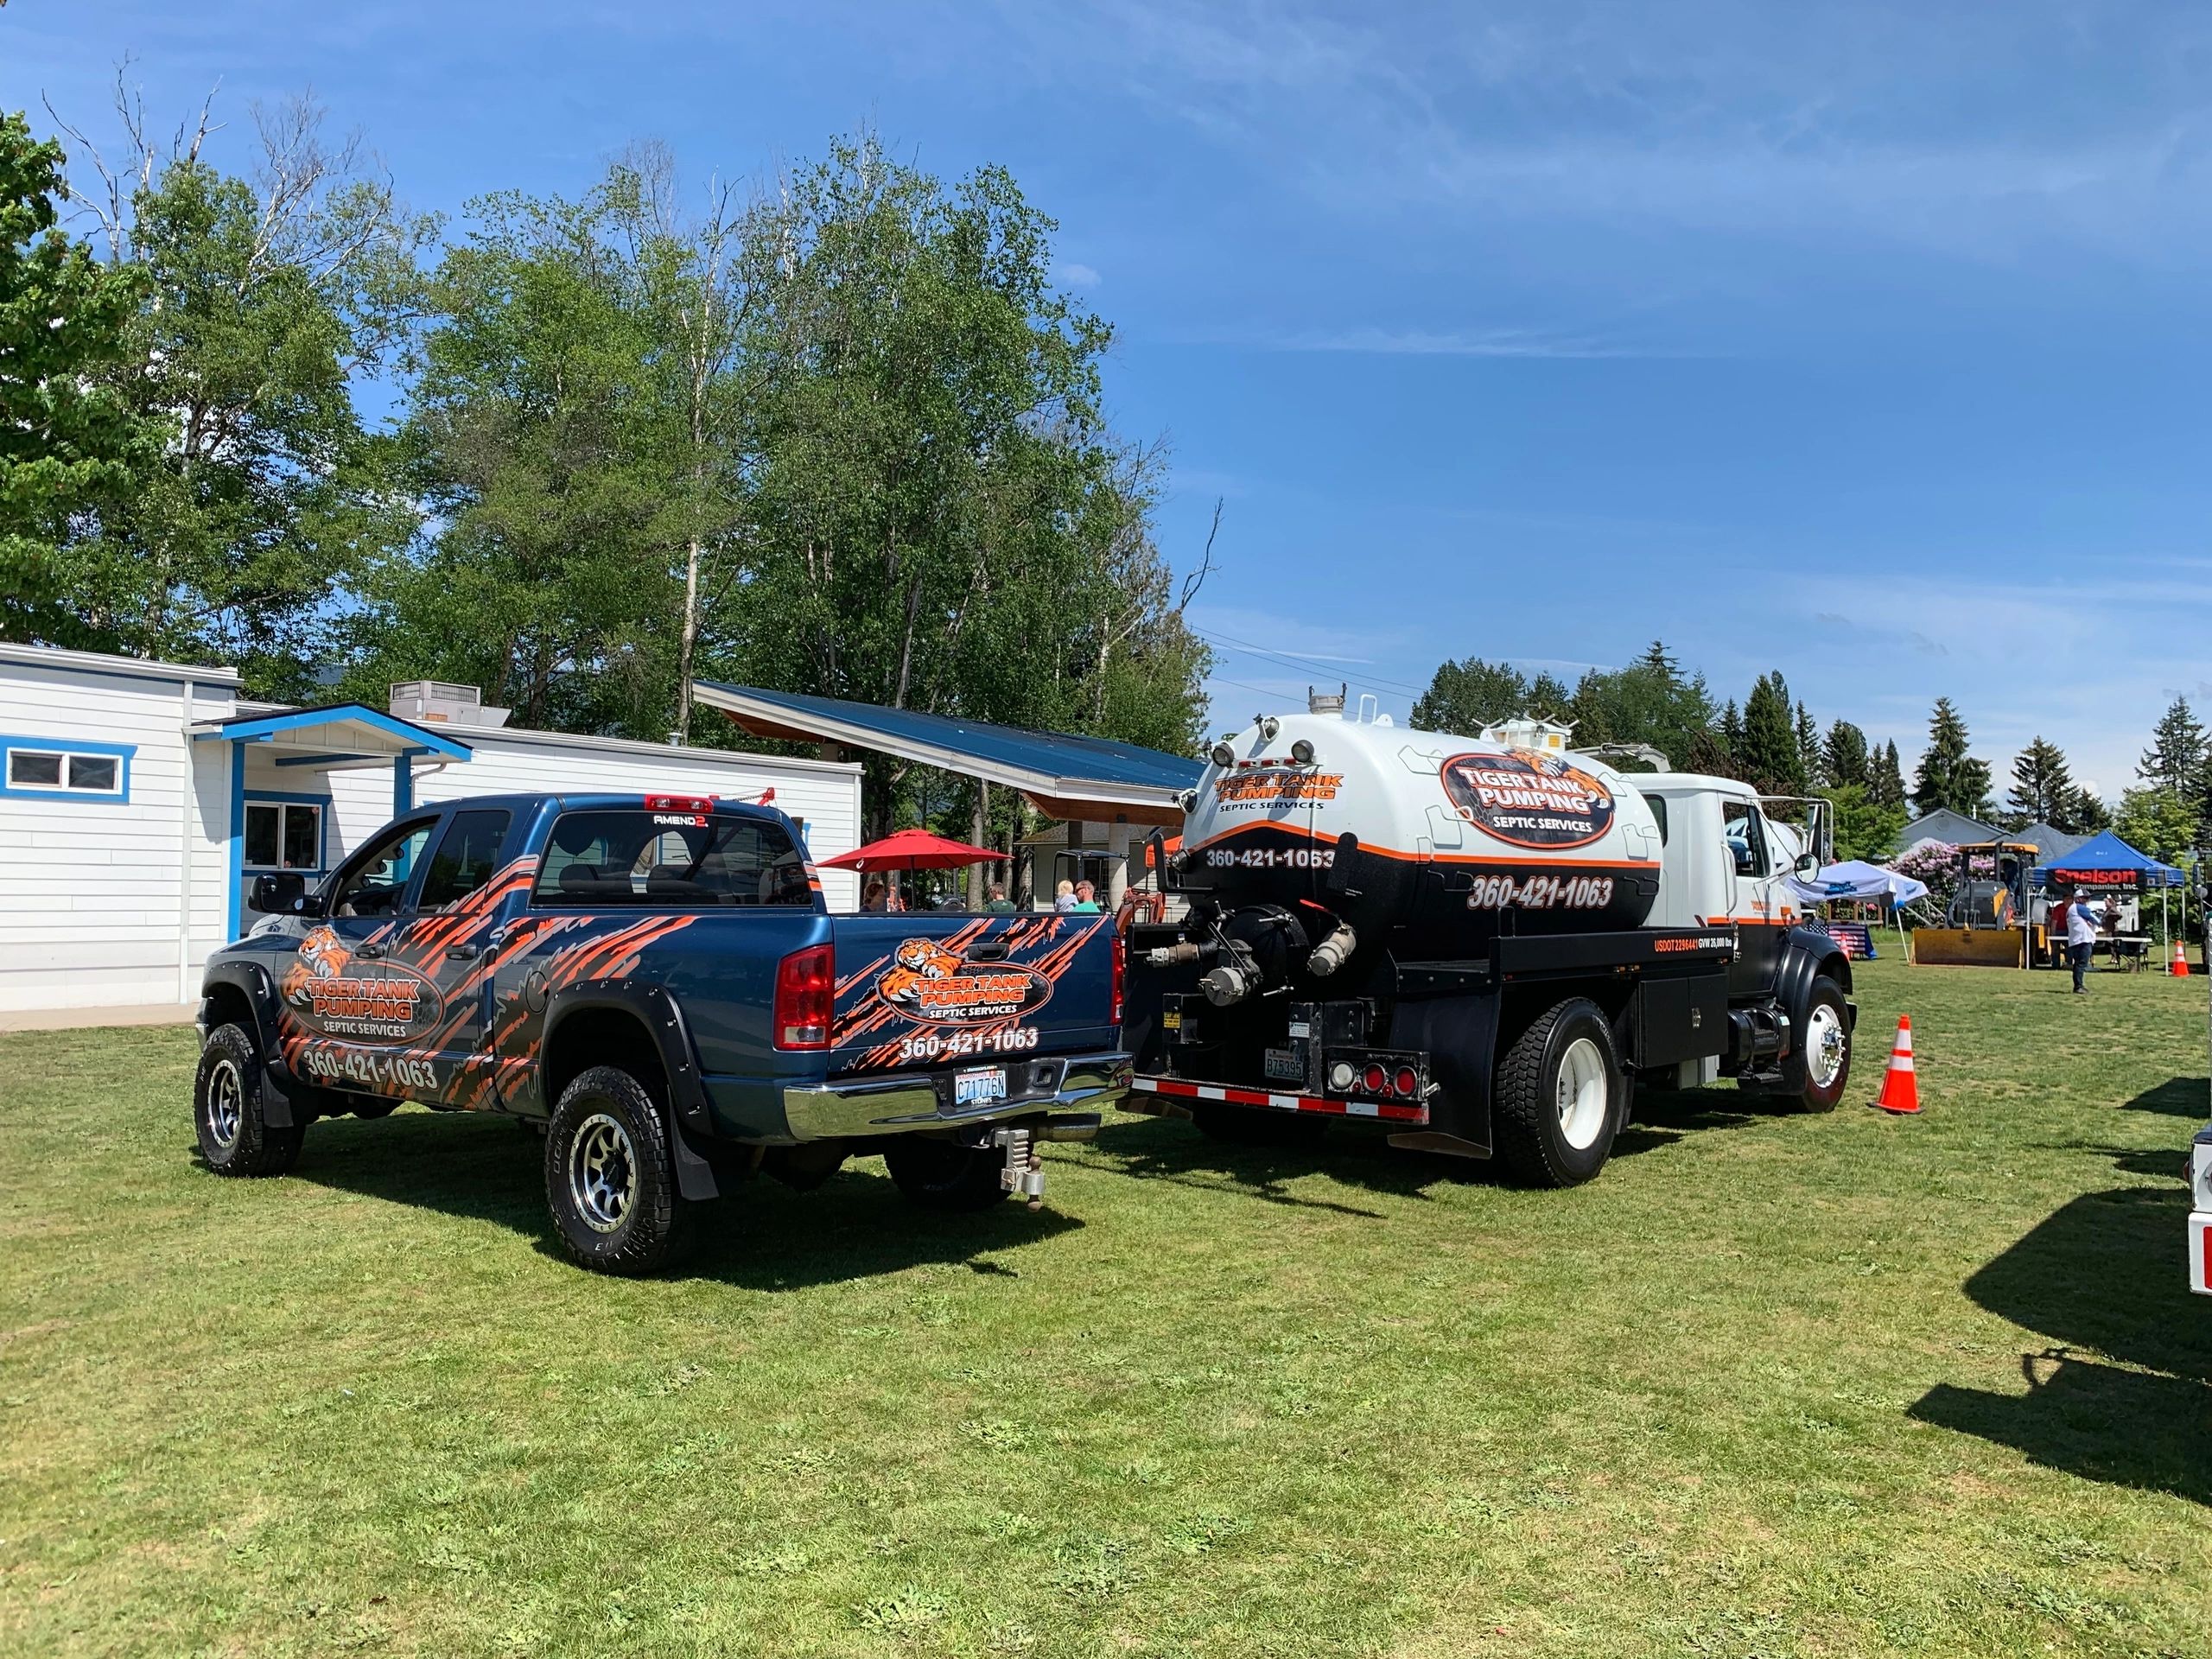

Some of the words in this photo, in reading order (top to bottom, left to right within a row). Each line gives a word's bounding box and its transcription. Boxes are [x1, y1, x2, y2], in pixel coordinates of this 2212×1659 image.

[1215, 774, 1270, 791] TIGER
[1272, 772, 1345, 787] TANK
[1456, 766, 1528, 790] TIGER
[1522, 773, 1587, 795] TANK
[1217, 785, 1336, 804] PUMPING
[1478, 787, 1591, 814] PUMPING
[1219, 802, 1256, 812] SEPTIC
[1493, 816, 1536, 830] SEPTIC
[1537, 817, 1592, 833] SERVICES
[1206, 849, 1336, 868] 360-421-1063
[2055, 868, 2138, 884] Snelson
[1467, 875, 1613, 909] 360-421-1063
[1654, 938, 1675, 952] USDOT
[1698, 938, 1710, 949] GVW
[307, 976, 361, 998] TIGER
[362, 978, 421, 1002] TANK
[914, 977, 977, 994] TIGER
[976, 973, 1033, 990] TANK
[920, 988, 1026, 1008] PUMPING
[313, 997, 413, 1022] PUMPING
[929, 1007, 968, 1019] SEPTIC
[968, 1004, 1017, 1016] SERVICES
[323, 1020, 357, 1033] SEPTIC
[359, 1022, 406, 1037] SERVICES
[898, 1027, 1039, 1060] 360-421-1063
[303, 1050, 439, 1090] 360-421-1063
[958, 1076, 1004, 1099] C71776N
